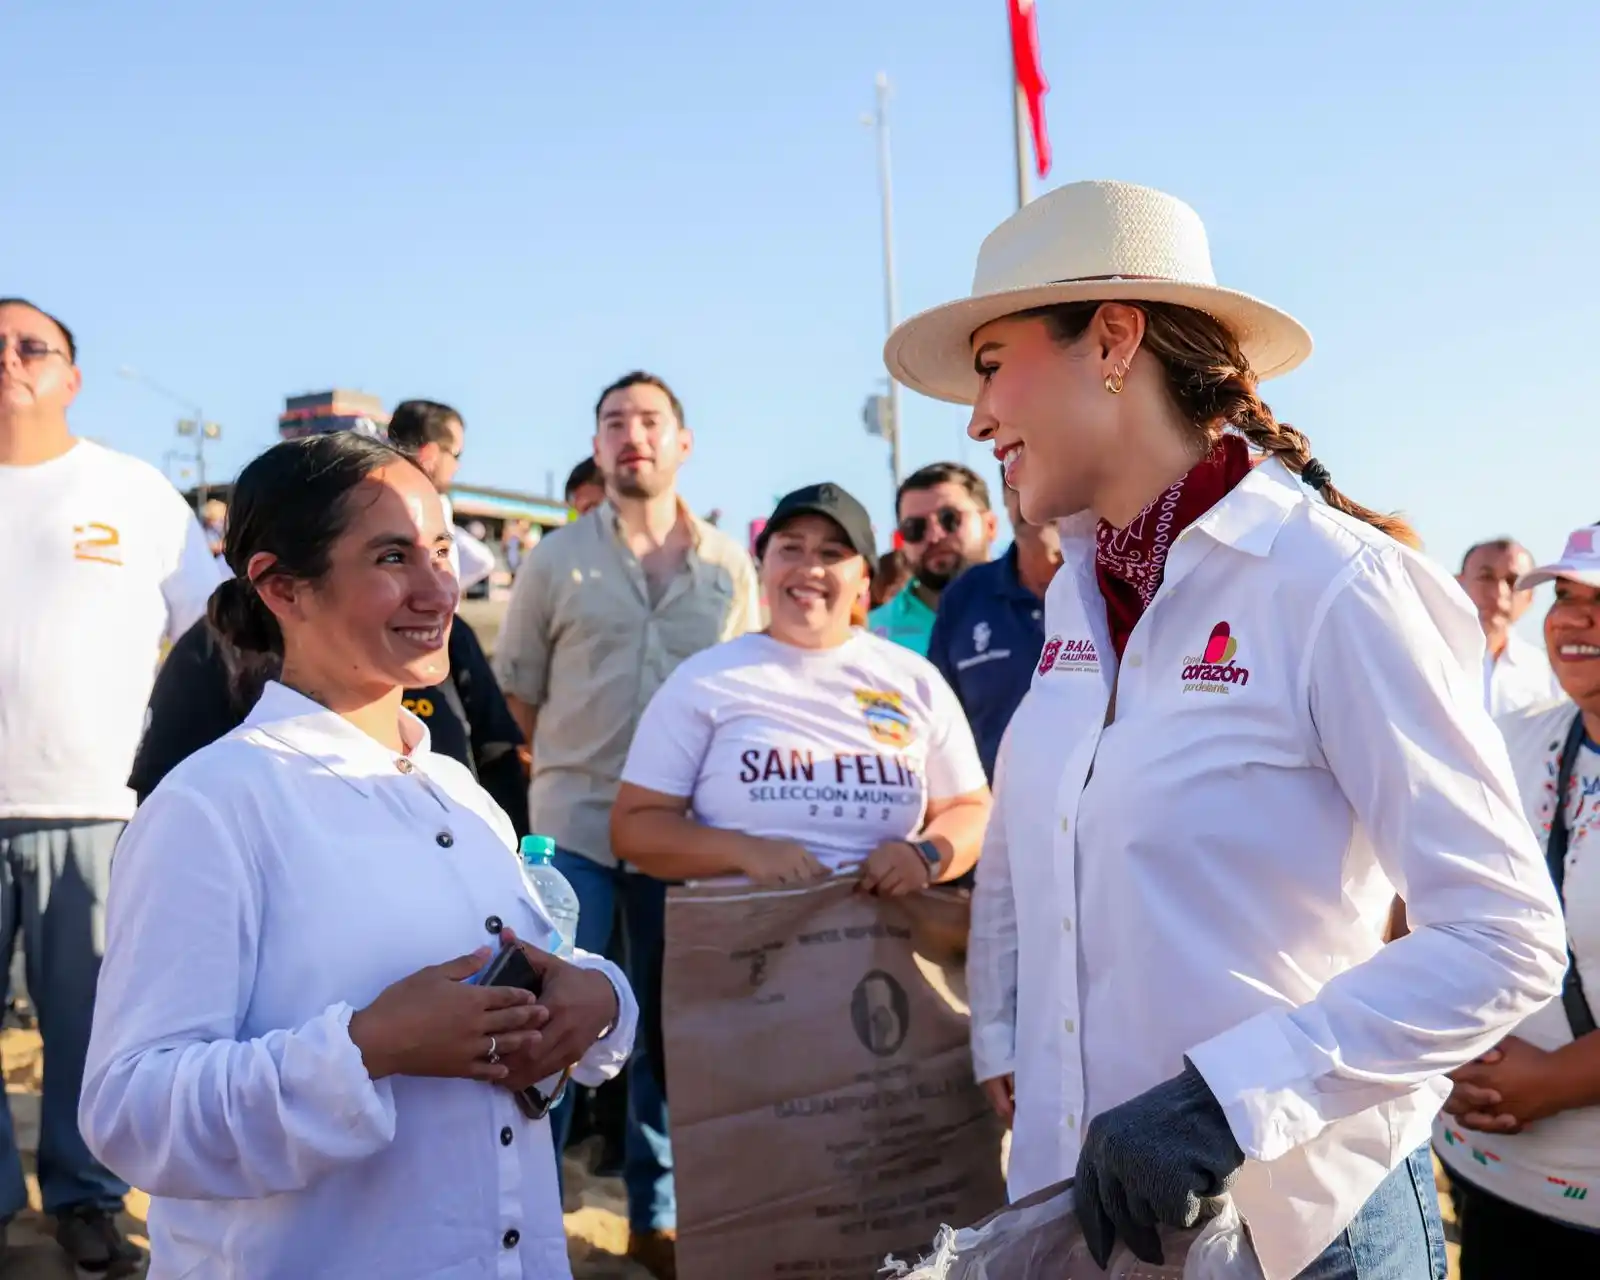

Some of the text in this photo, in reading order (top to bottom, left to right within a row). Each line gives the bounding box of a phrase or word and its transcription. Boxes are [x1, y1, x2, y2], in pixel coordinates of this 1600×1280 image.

[1064, 640, 1096, 654] BAJA
[1060, 653, 1098, 662] CALIFORN
[1181, 659, 1249, 686] corazón
[739, 748, 815, 784] SAN
[749, 785, 849, 803] SELECCIÓN
